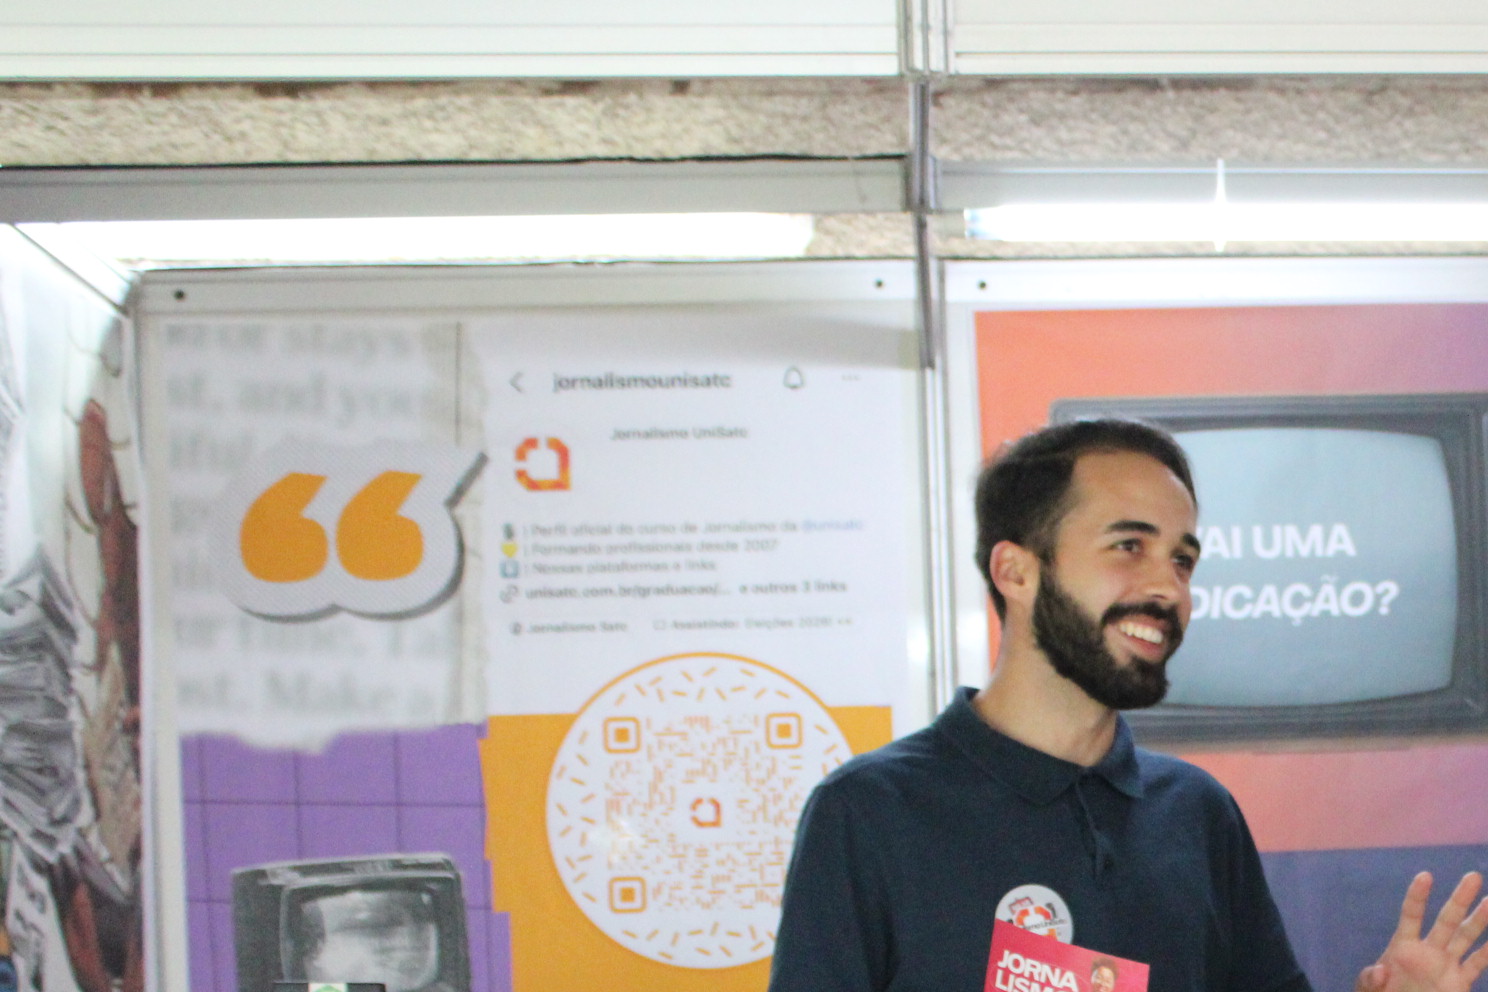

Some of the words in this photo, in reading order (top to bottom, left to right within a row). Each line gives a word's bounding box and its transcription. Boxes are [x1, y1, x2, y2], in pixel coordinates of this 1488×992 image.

[553, 372, 732, 393] jornalismounisatc
[610, 427, 689, 441] Jornalismo
[1197, 525, 1243, 560] AI
[1253, 523, 1357, 559] UMA
[997, 949, 1079, 992] JORNA
